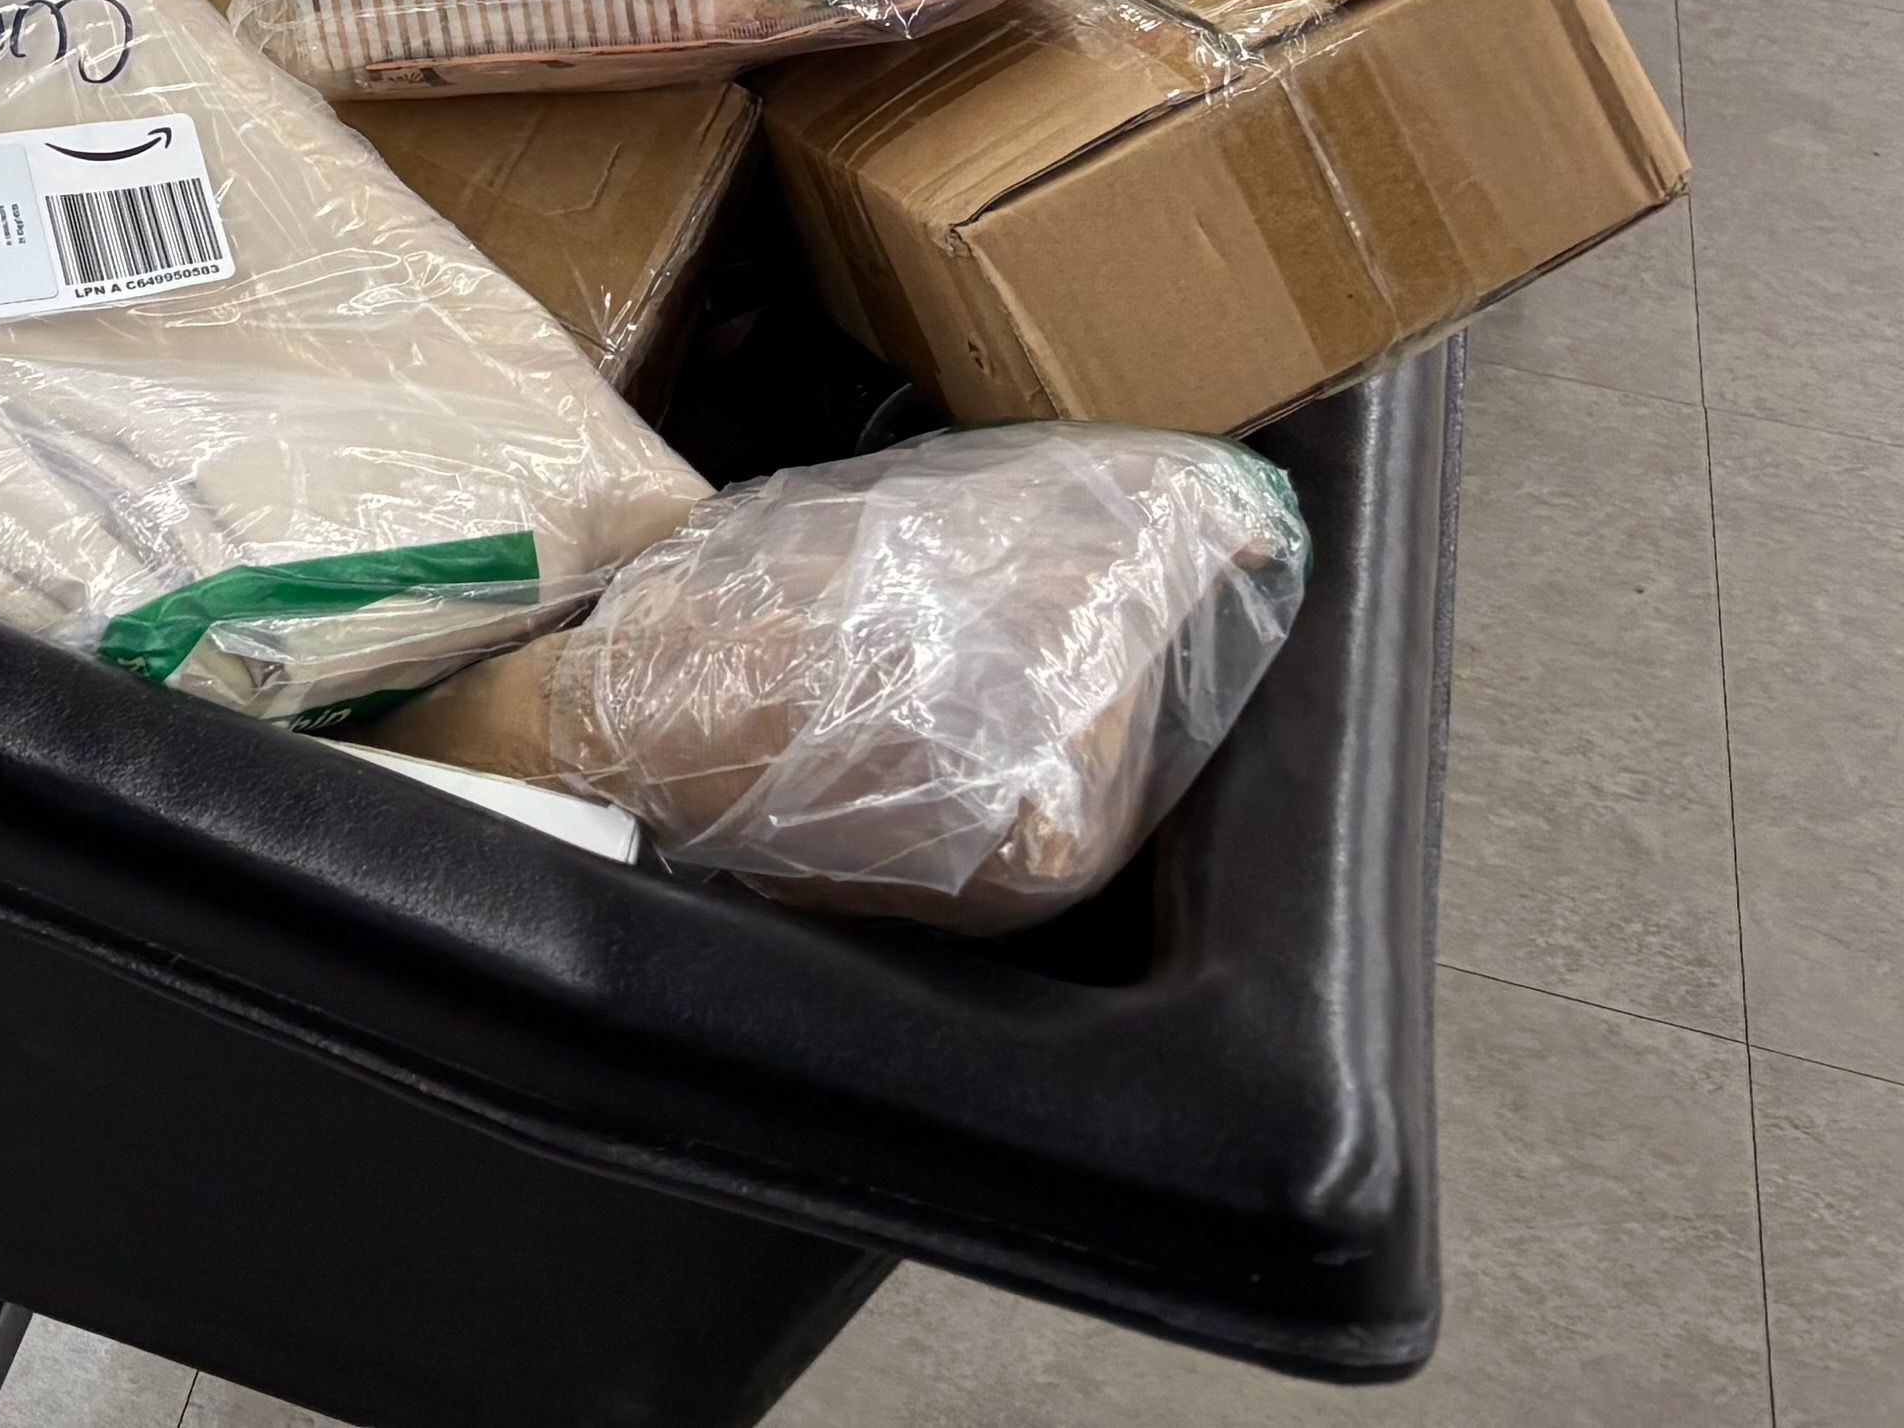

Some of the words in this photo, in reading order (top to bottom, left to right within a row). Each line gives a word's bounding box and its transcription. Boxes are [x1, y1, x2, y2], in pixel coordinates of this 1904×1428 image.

[74, 283, 106, 301] LPN
[110, 281, 124, 294] A
[124, 263, 221, 293] C649950583
[284, 706, 352, 734] hip
